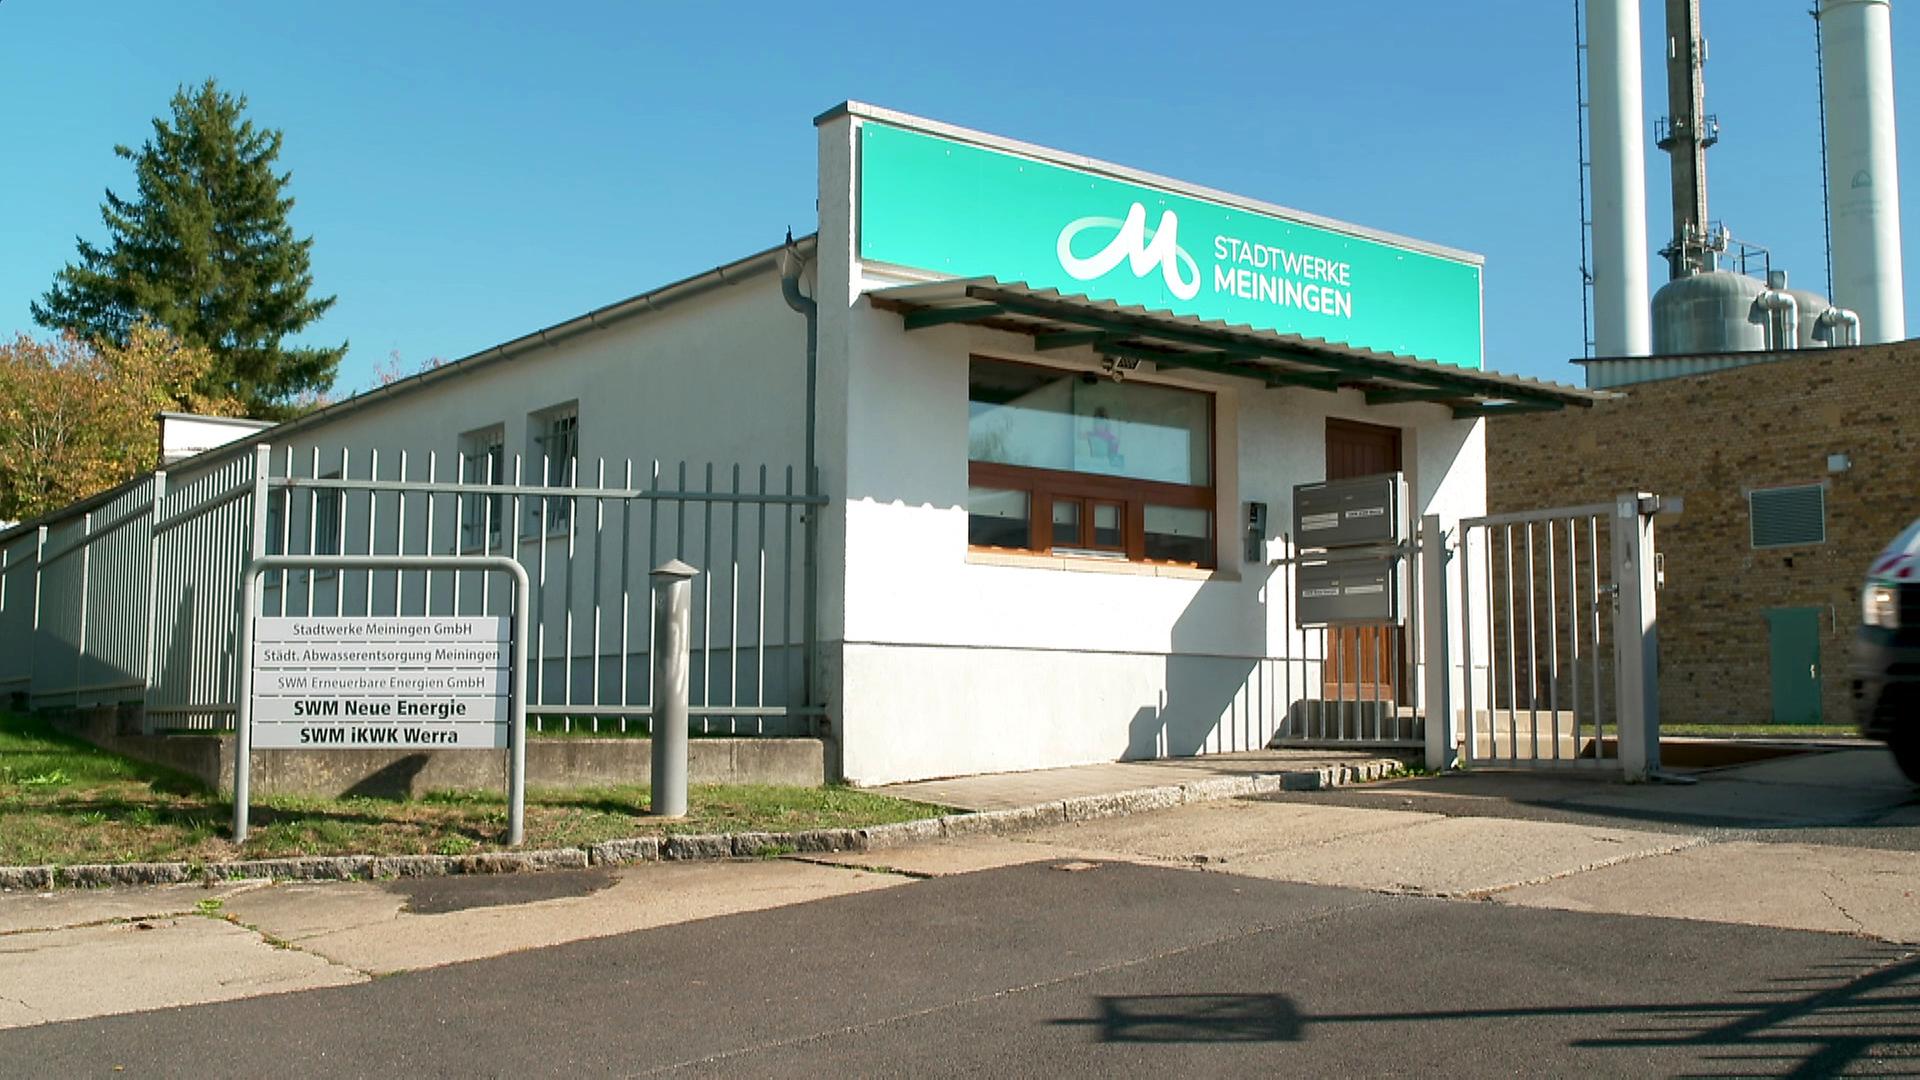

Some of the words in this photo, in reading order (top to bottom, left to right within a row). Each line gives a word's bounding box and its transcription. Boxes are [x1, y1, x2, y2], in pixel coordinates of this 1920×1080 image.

[1214, 235, 1350, 287] STADTWERKE
[1214, 264, 1352, 319] MEININGEN
[293, 623, 363, 636] Stadtwerke
[365, 623, 431, 636] Meiningen
[434, 623, 472, 636] GmbH
[303, 649, 432, 663] Abwasserentsorgung
[435, 648, 500, 663] Meiningen
[278, 677, 307, 689] SWM
[311, 677, 386, 689] Erneuerbare
[389, 677, 444, 691] Energien
[447, 676, 485, 689] GmbH
[294, 700, 338, 716] SWM
[345, 700, 391, 716] Neue
[397, 699, 466, 719] Energie
[300, 728, 345, 744] SWM
[351, 727, 398, 744] iKWK
[404, 728, 458, 744] Werra
